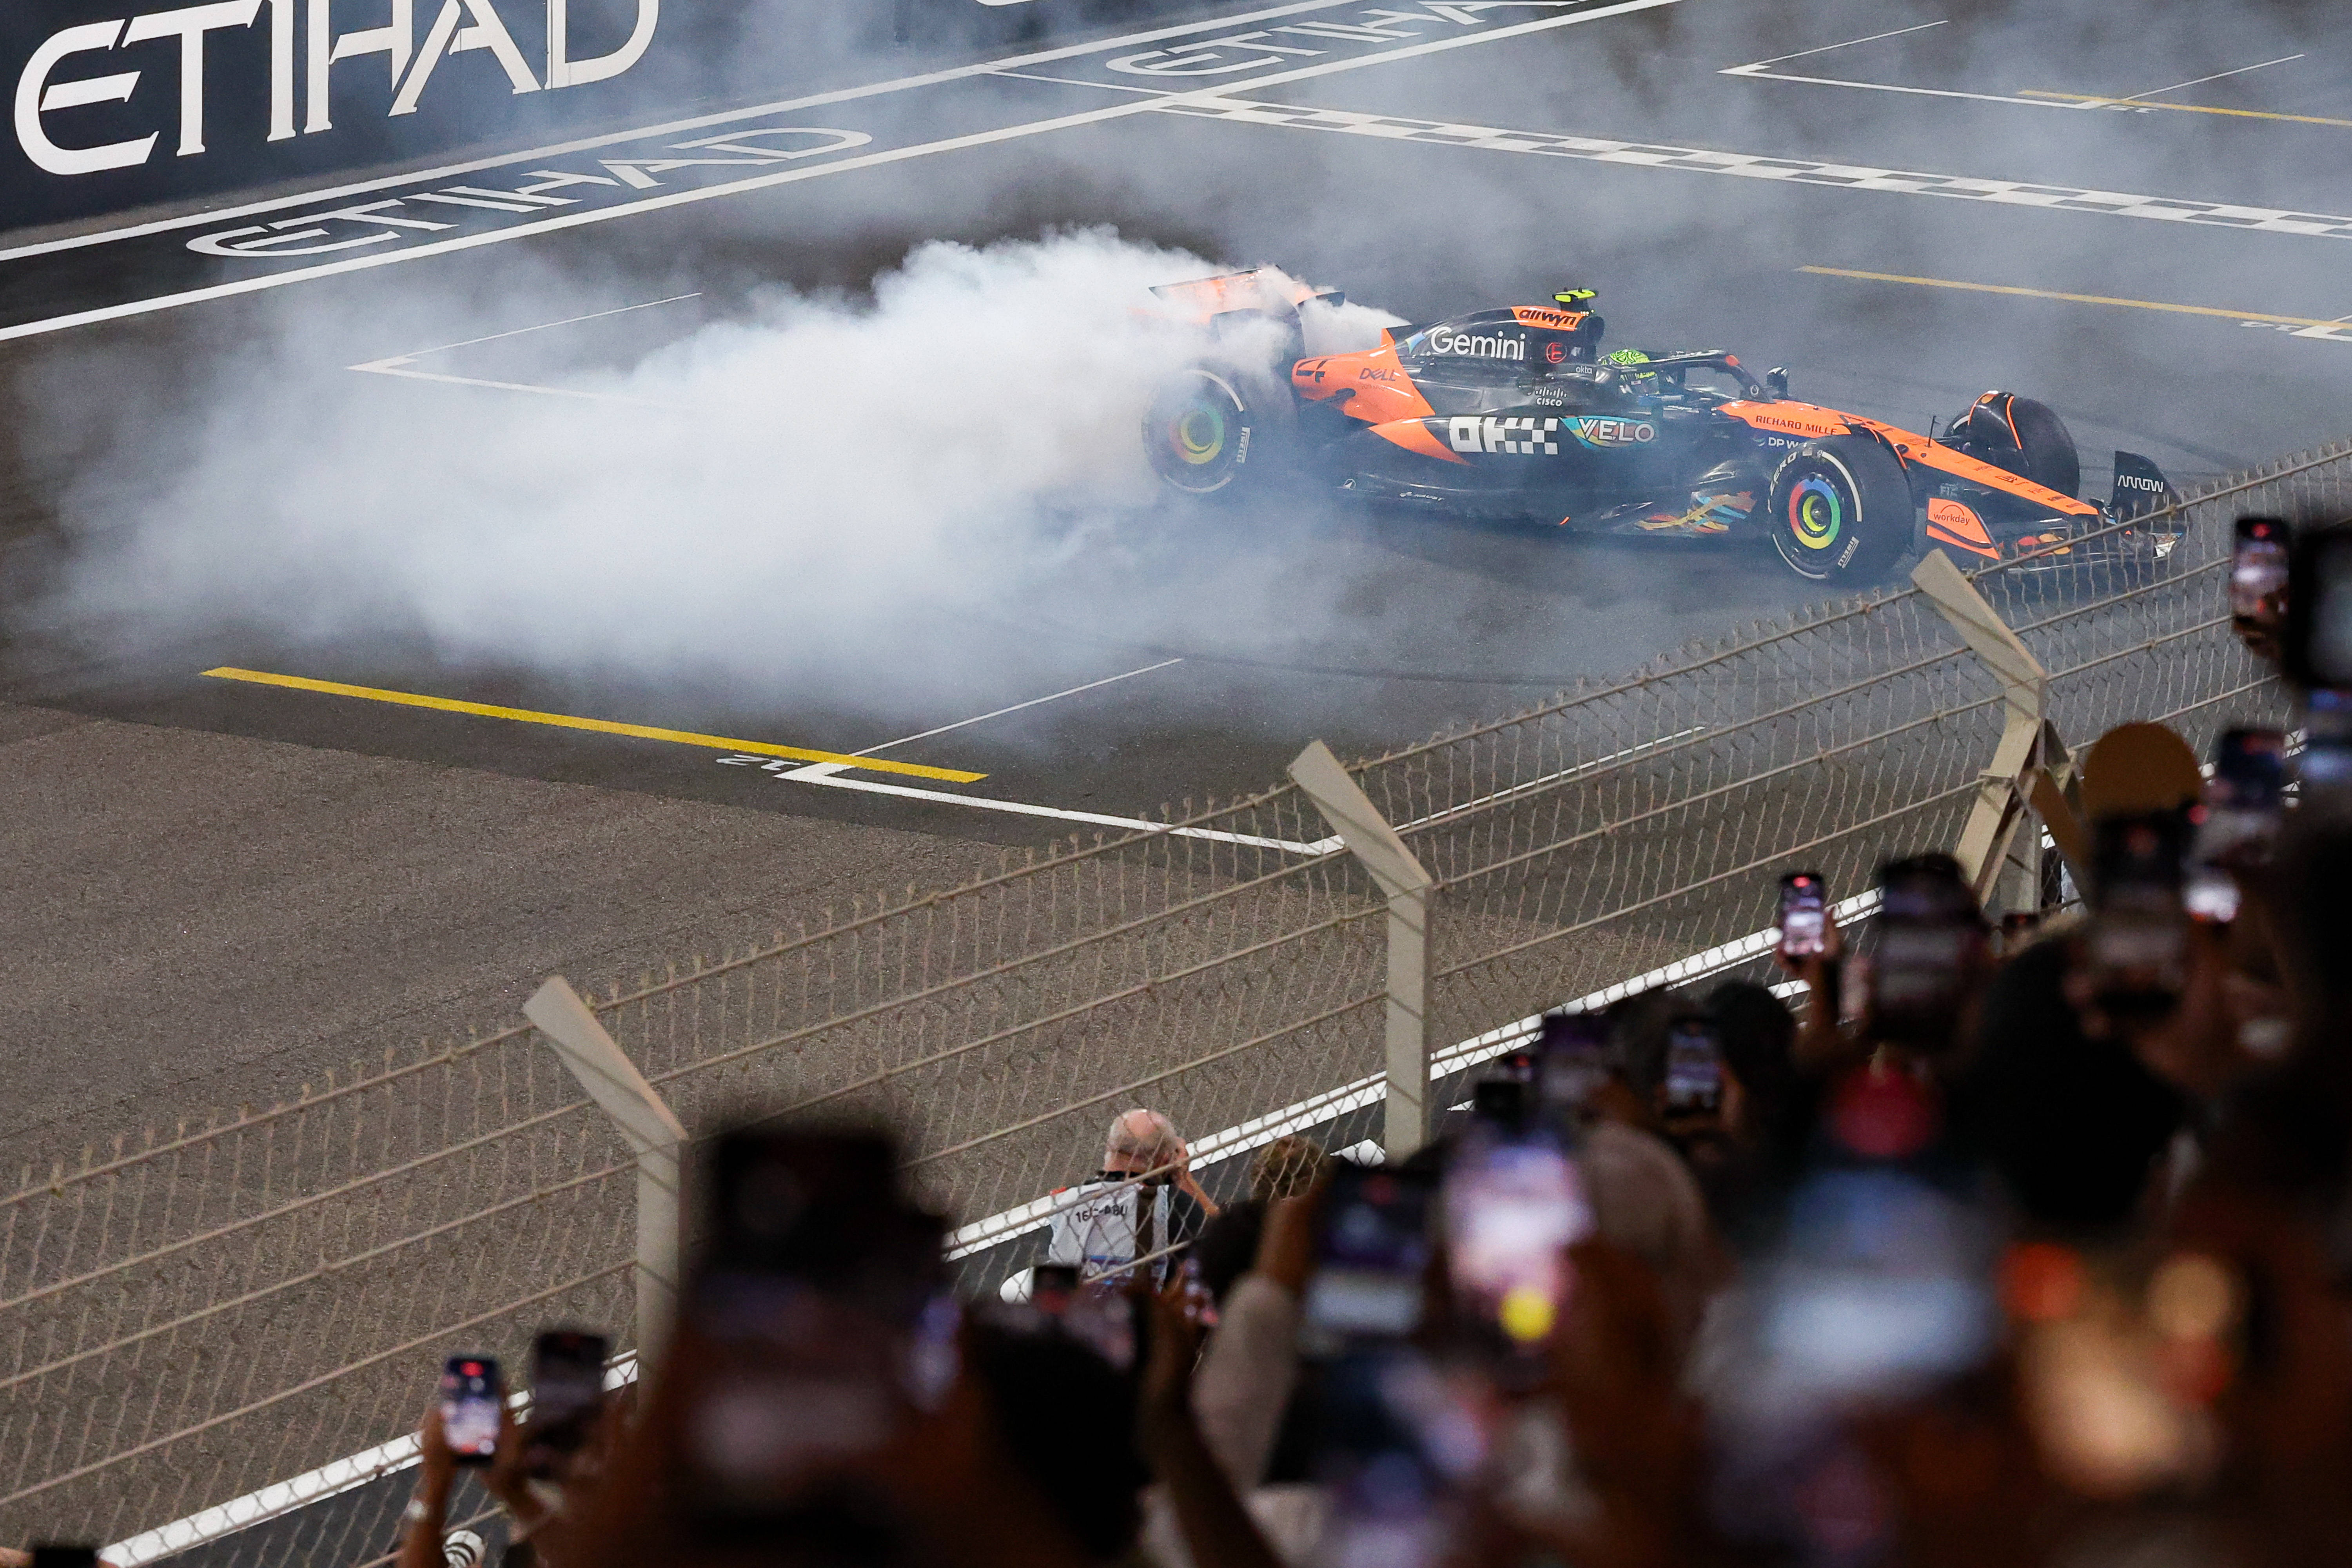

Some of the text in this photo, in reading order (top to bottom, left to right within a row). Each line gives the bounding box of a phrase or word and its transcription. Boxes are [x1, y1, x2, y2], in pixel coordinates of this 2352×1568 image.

[1106, 0, 1592, 76] ETIHA
[15, 0, 659, 175] ETIHAD
[186, 127, 873, 257] ETIHAD
[1519, 309, 1577, 326] allwyn
[1430, 326, 1526, 361] Gemini
[1359, 368, 1396, 381] DELL
[1575, 365, 1592, 374] okta
[1579, 418, 1655, 442] VELO
[1755, 415, 1802, 430] RICHARD
[1449, 416, 1558, 455] OKX
[1768, 437, 1785, 447] DP
[2117, 475, 2164, 493] ARROW
[1933, 514, 1971, 526] workday
